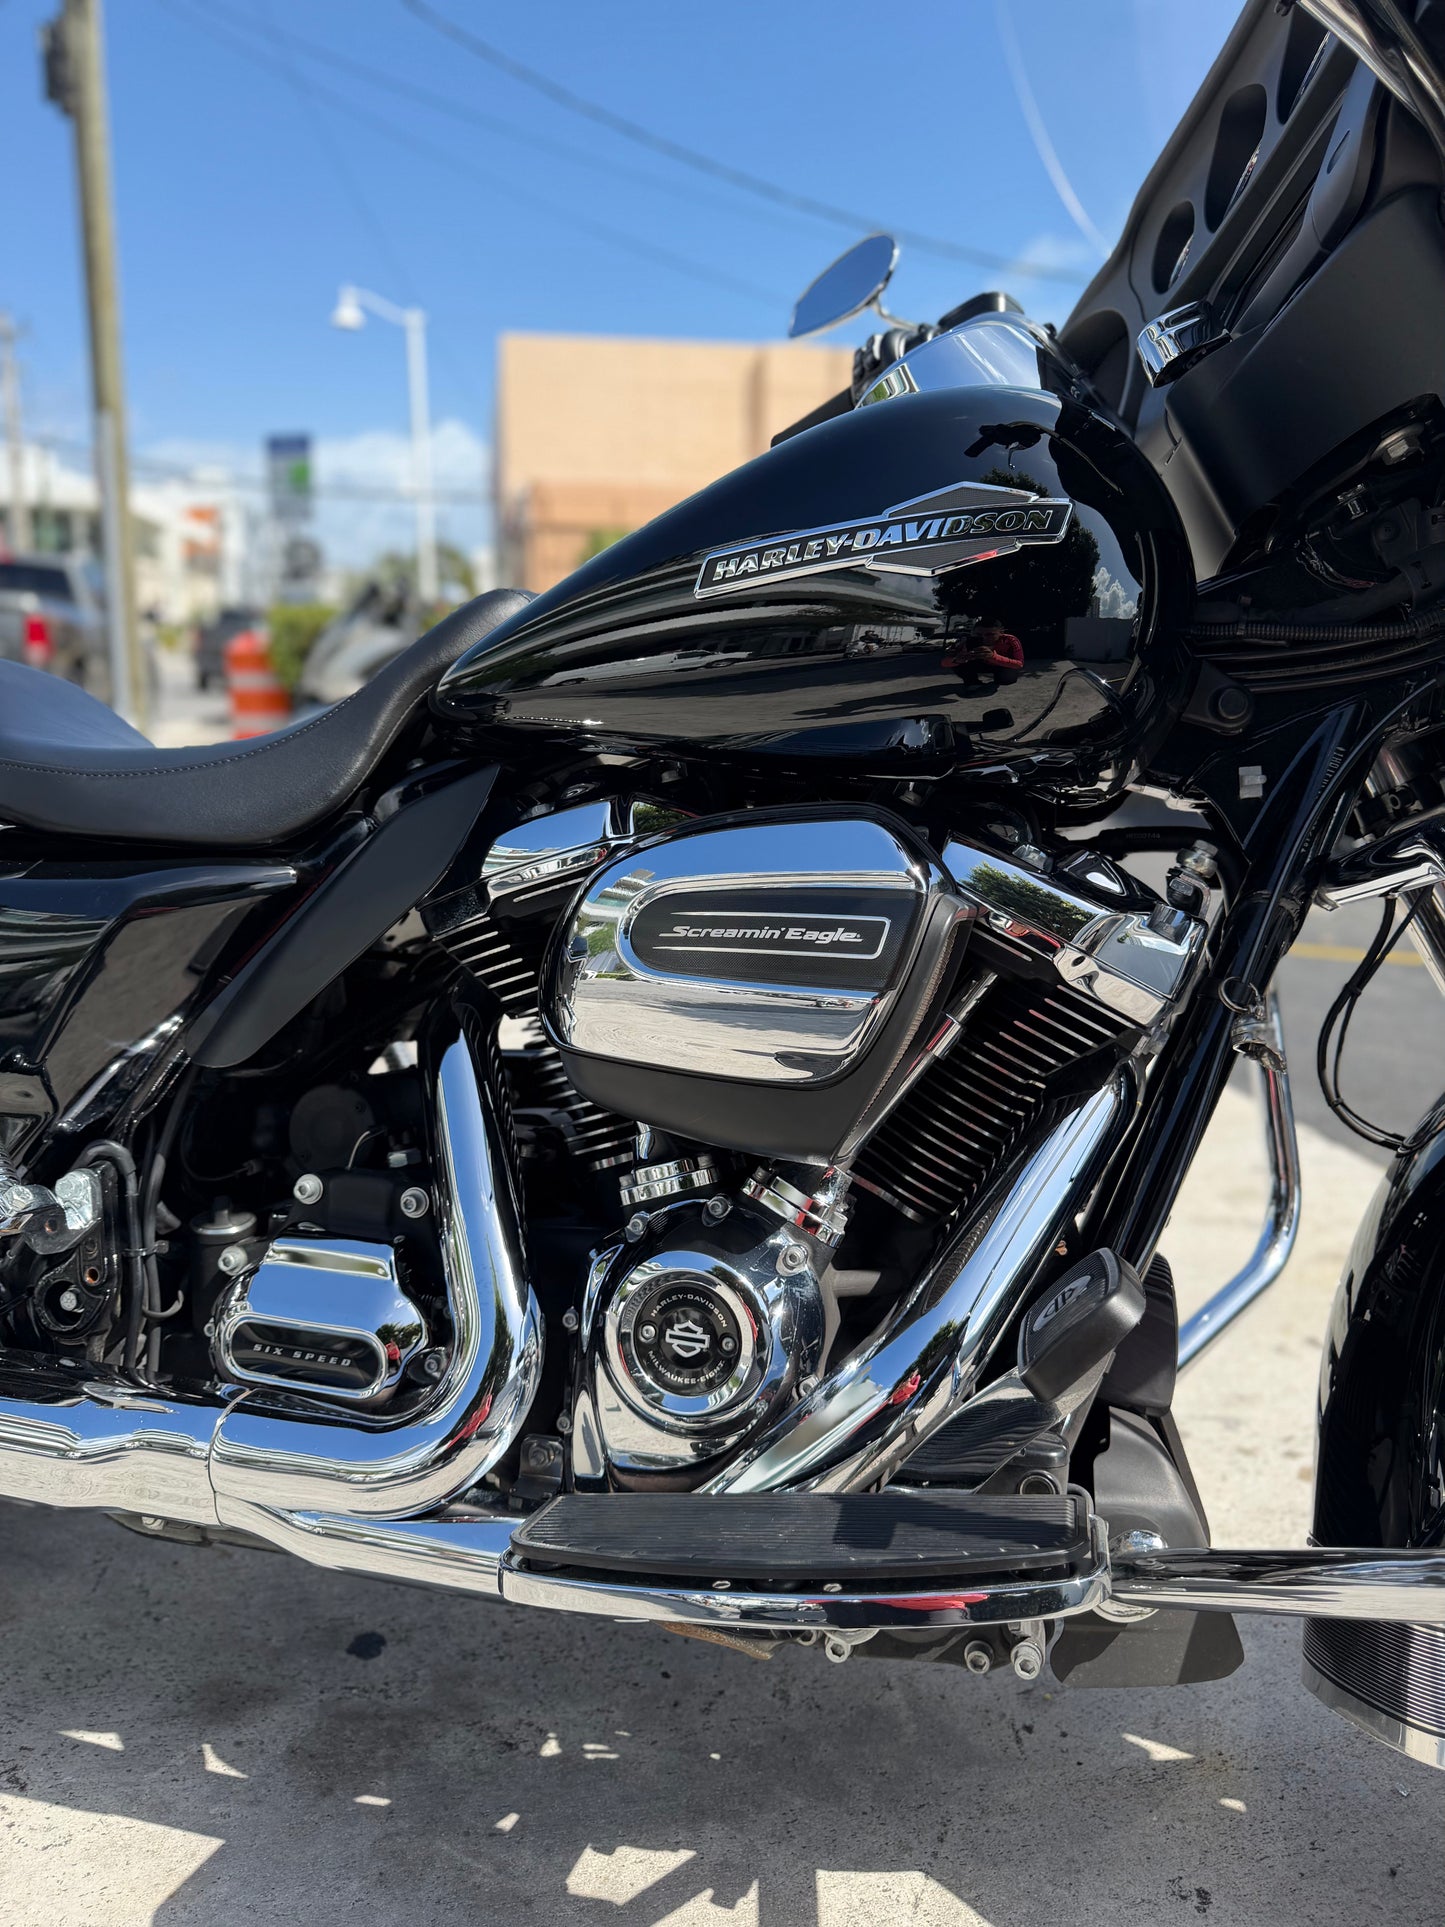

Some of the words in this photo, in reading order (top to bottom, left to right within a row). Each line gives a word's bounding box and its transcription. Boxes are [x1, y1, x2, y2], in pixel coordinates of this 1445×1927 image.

[713, 510, 1053, 581] HARLEY-DAVIDSON
[659, 925, 786, 938] Screamin'
[253, 1343, 284, 1356] SIX
[292, 1350, 352, 1367] SPEED
